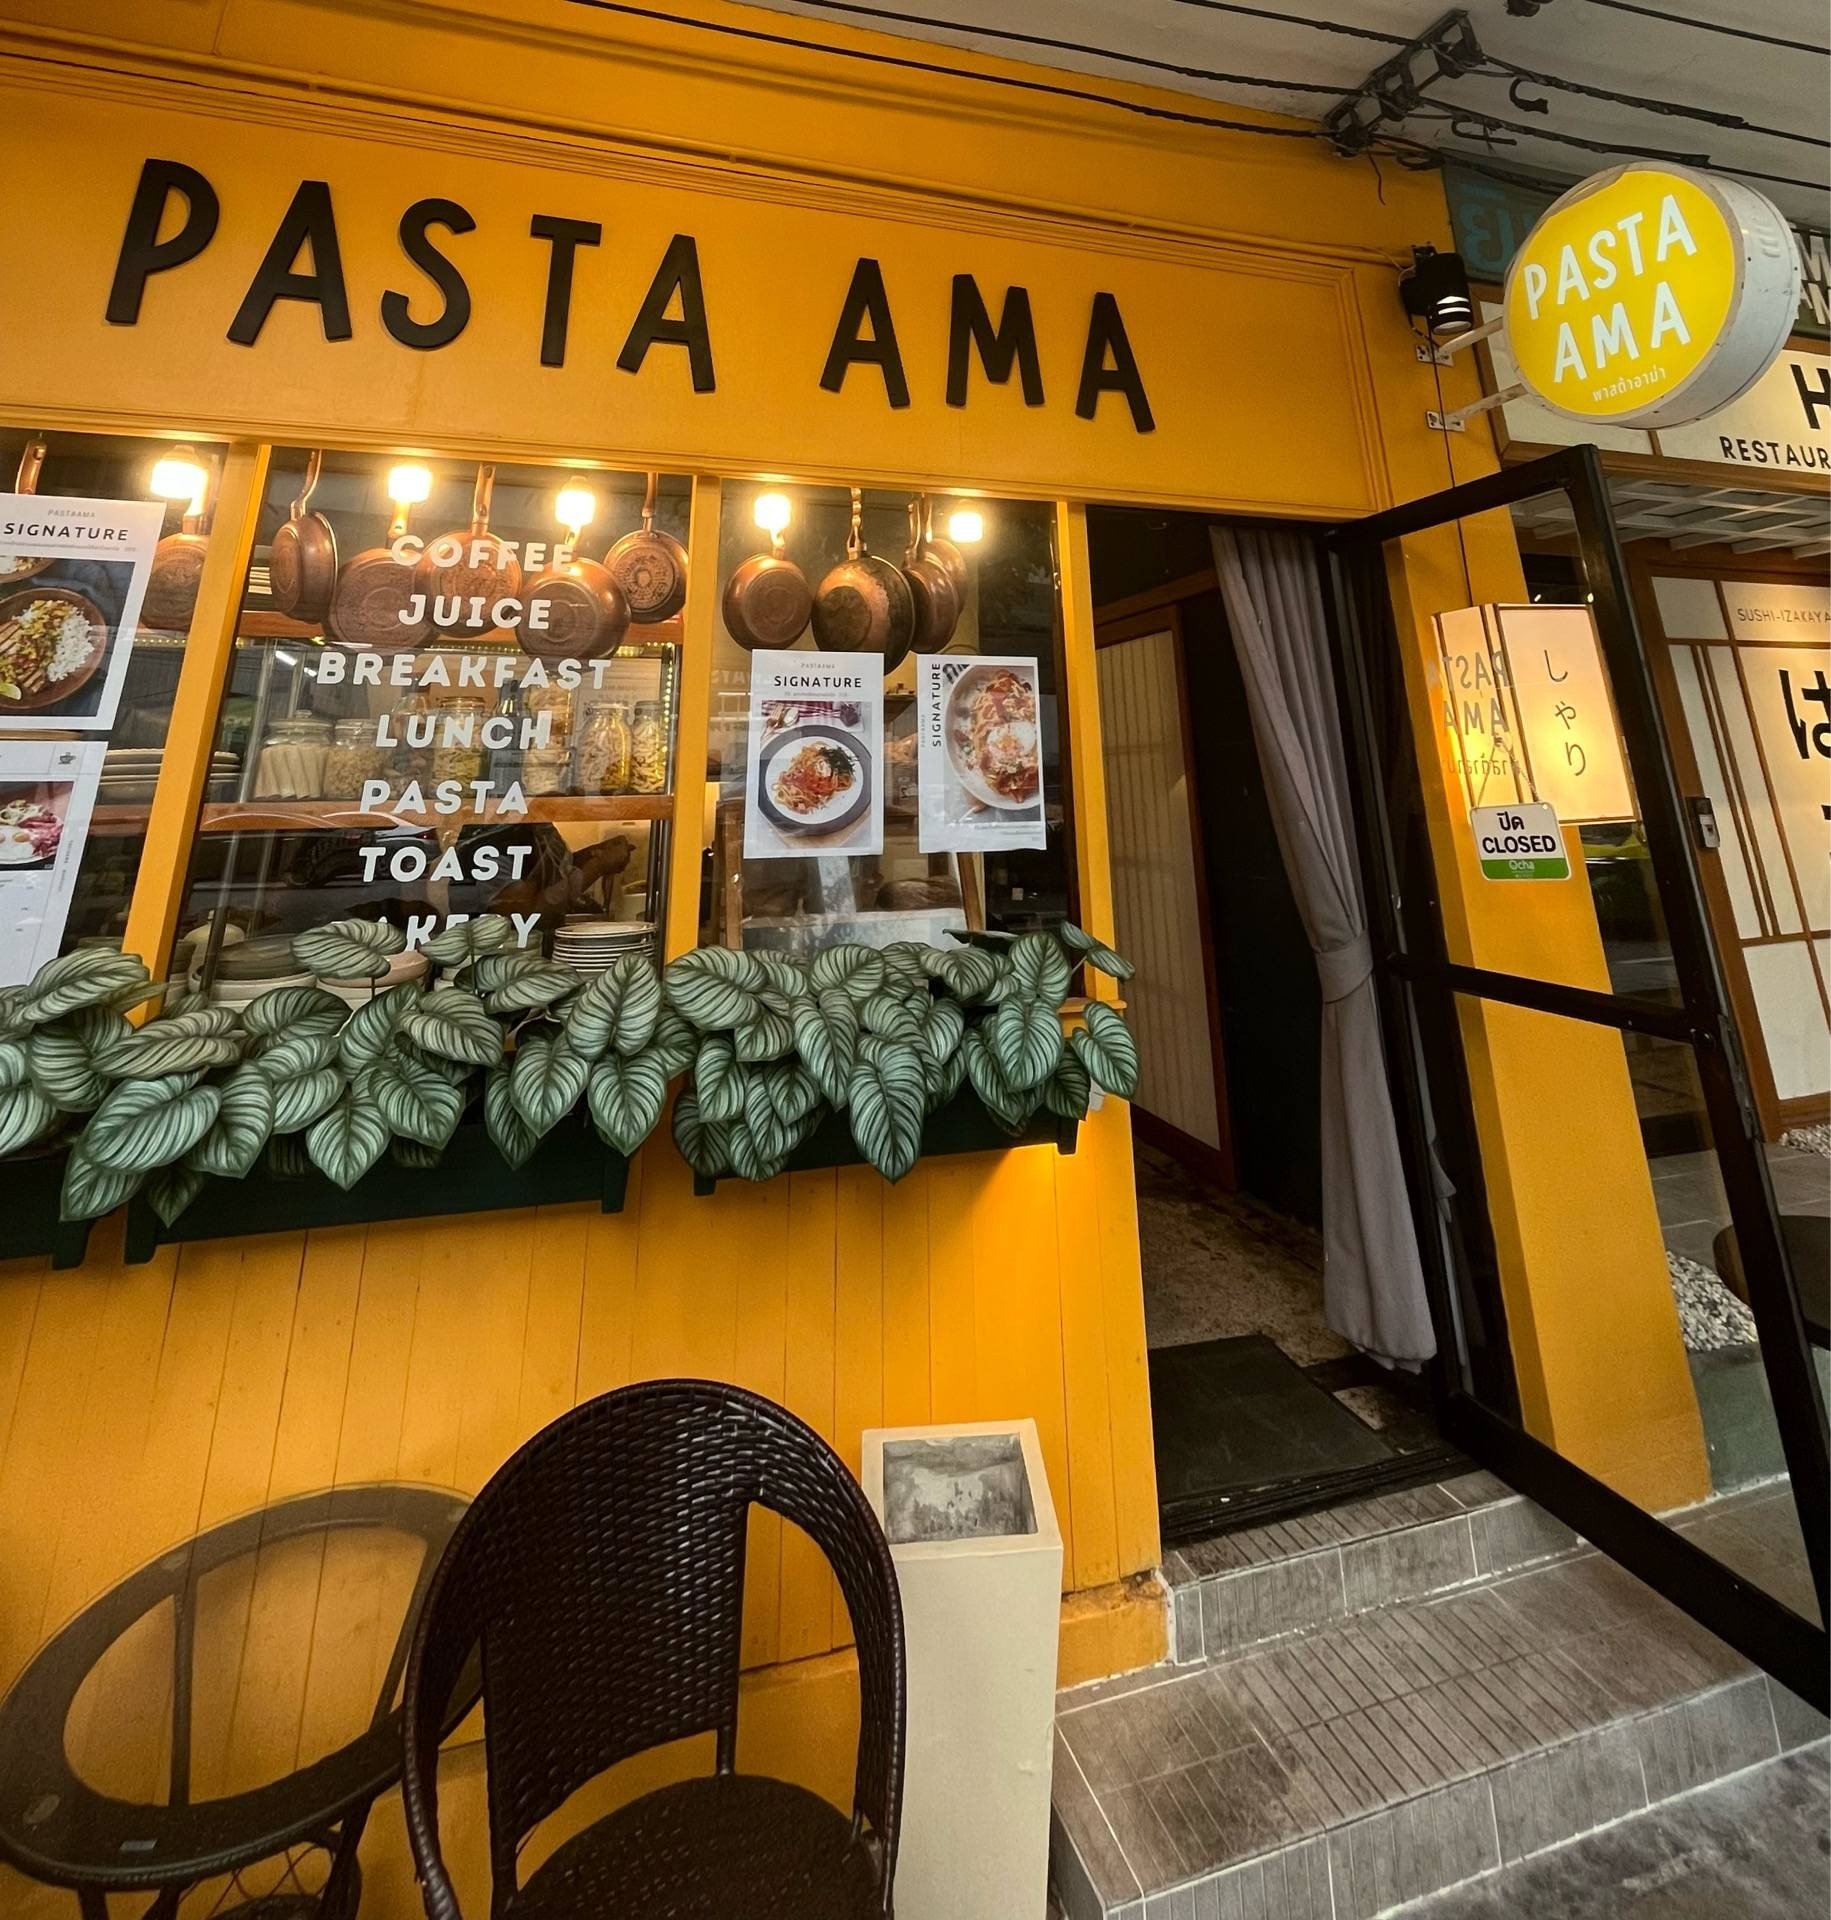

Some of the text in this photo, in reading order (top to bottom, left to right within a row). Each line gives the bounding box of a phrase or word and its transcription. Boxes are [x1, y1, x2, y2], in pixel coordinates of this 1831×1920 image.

[1523, 193, 1698, 320] PASTA
[105, 157, 1156, 433] PASTA AMA
[1554, 281, 1691, 383] AMA
[1592, 363, 1666, 402] พาสต้าอาม่า
[1719, 436, 1831, 469] RESTAUR
[3, 522, 128, 541] SIGNATURE
[391, 535, 574, 573] COFFEE
[398, 594, 552, 630] JUICE
[1737, 608, 1831, 624] SUSHI-IZAKAYA
[317, 651, 611, 690] BREAKFAST
[774, 675, 862, 688] SIGNATURE
[932, 663, 941, 747] SIGNATURE
[375, 711, 552, 750] LUNCH
[359, 780, 528, 814] PASTA
[1496, 811, 1525, 831] ปิด
[1482, 836, 1556, 853] CLOSED
[358, 846, 532, 883] TOAST
[1509, 860, 1535, 870] Ocha
